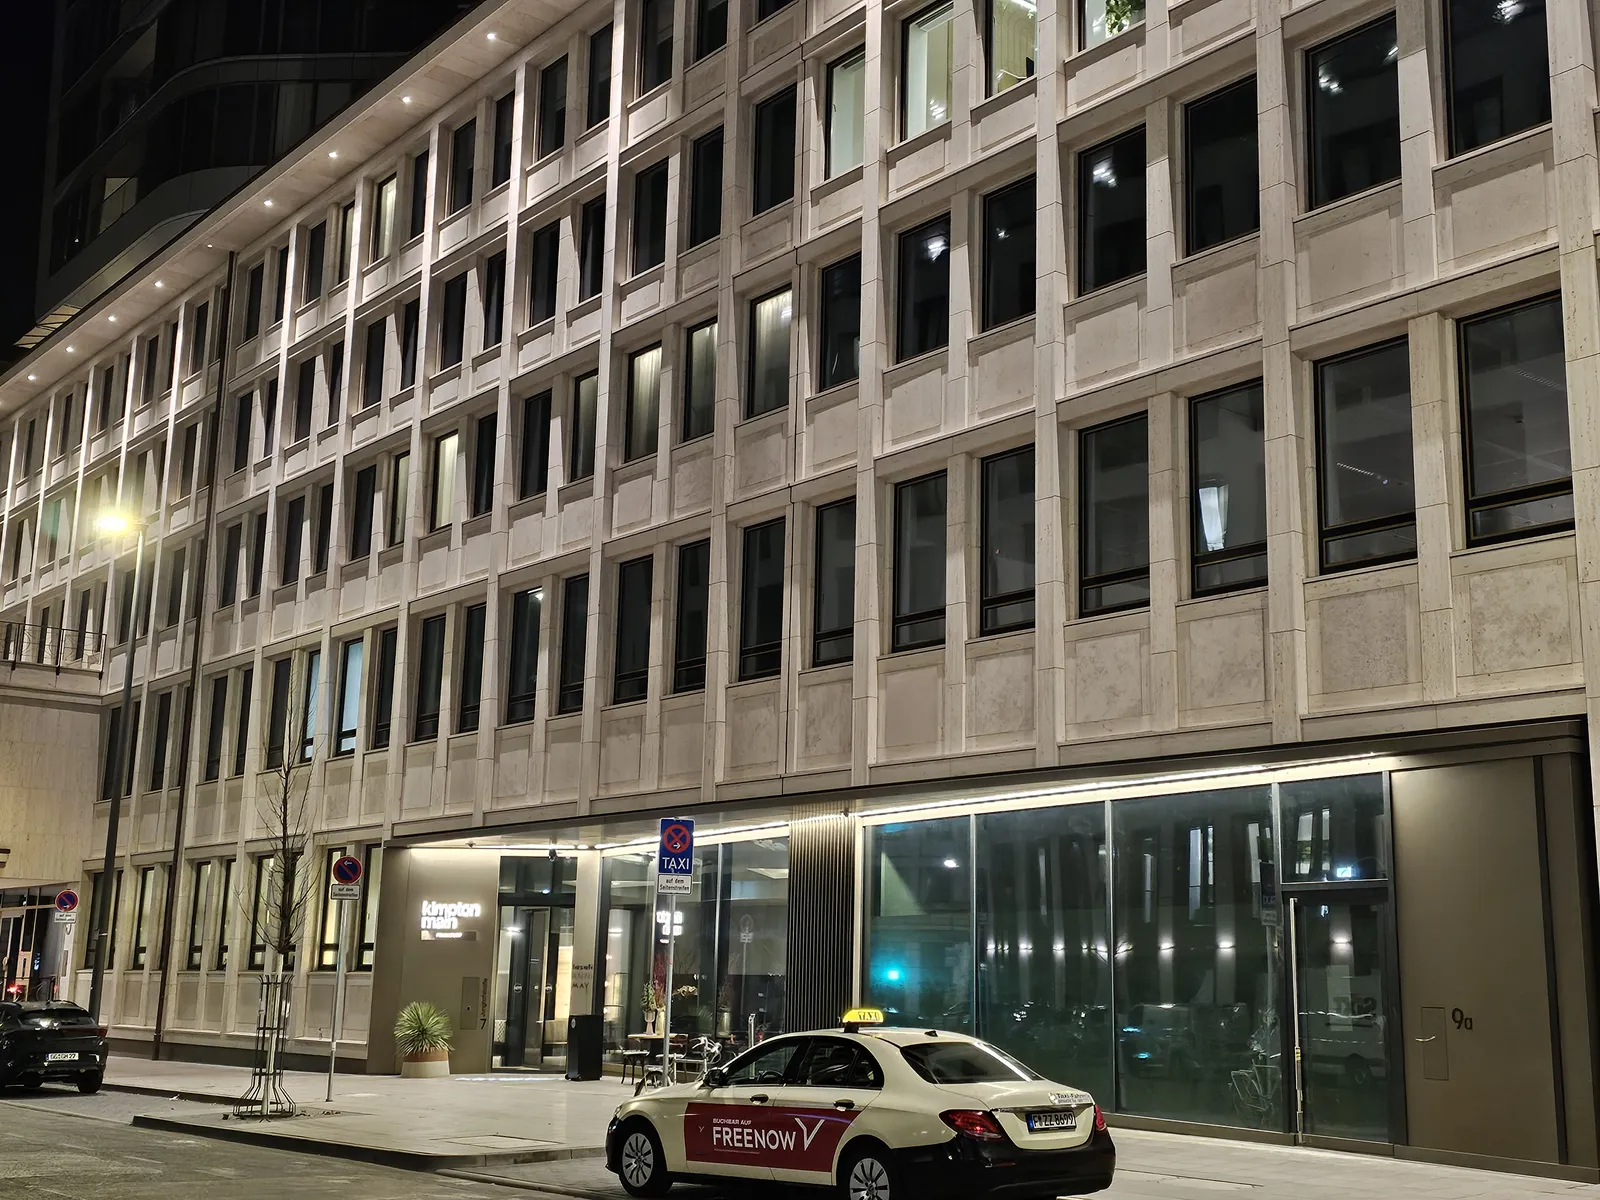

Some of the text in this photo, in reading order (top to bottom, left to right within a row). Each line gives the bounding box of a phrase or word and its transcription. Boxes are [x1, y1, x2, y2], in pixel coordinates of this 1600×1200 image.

[662, 857, 689, 870] TAXI
[422, 900, 481, 918] kimpton
[421, 916, 458, 929] main
[858, 1011, 880, 1020] TAXI
[1452, 1008, 1472, 1030] 9a
[480, 1019, 487, 1030] 7
[712, 1126, 796, 1151] FREENOW
